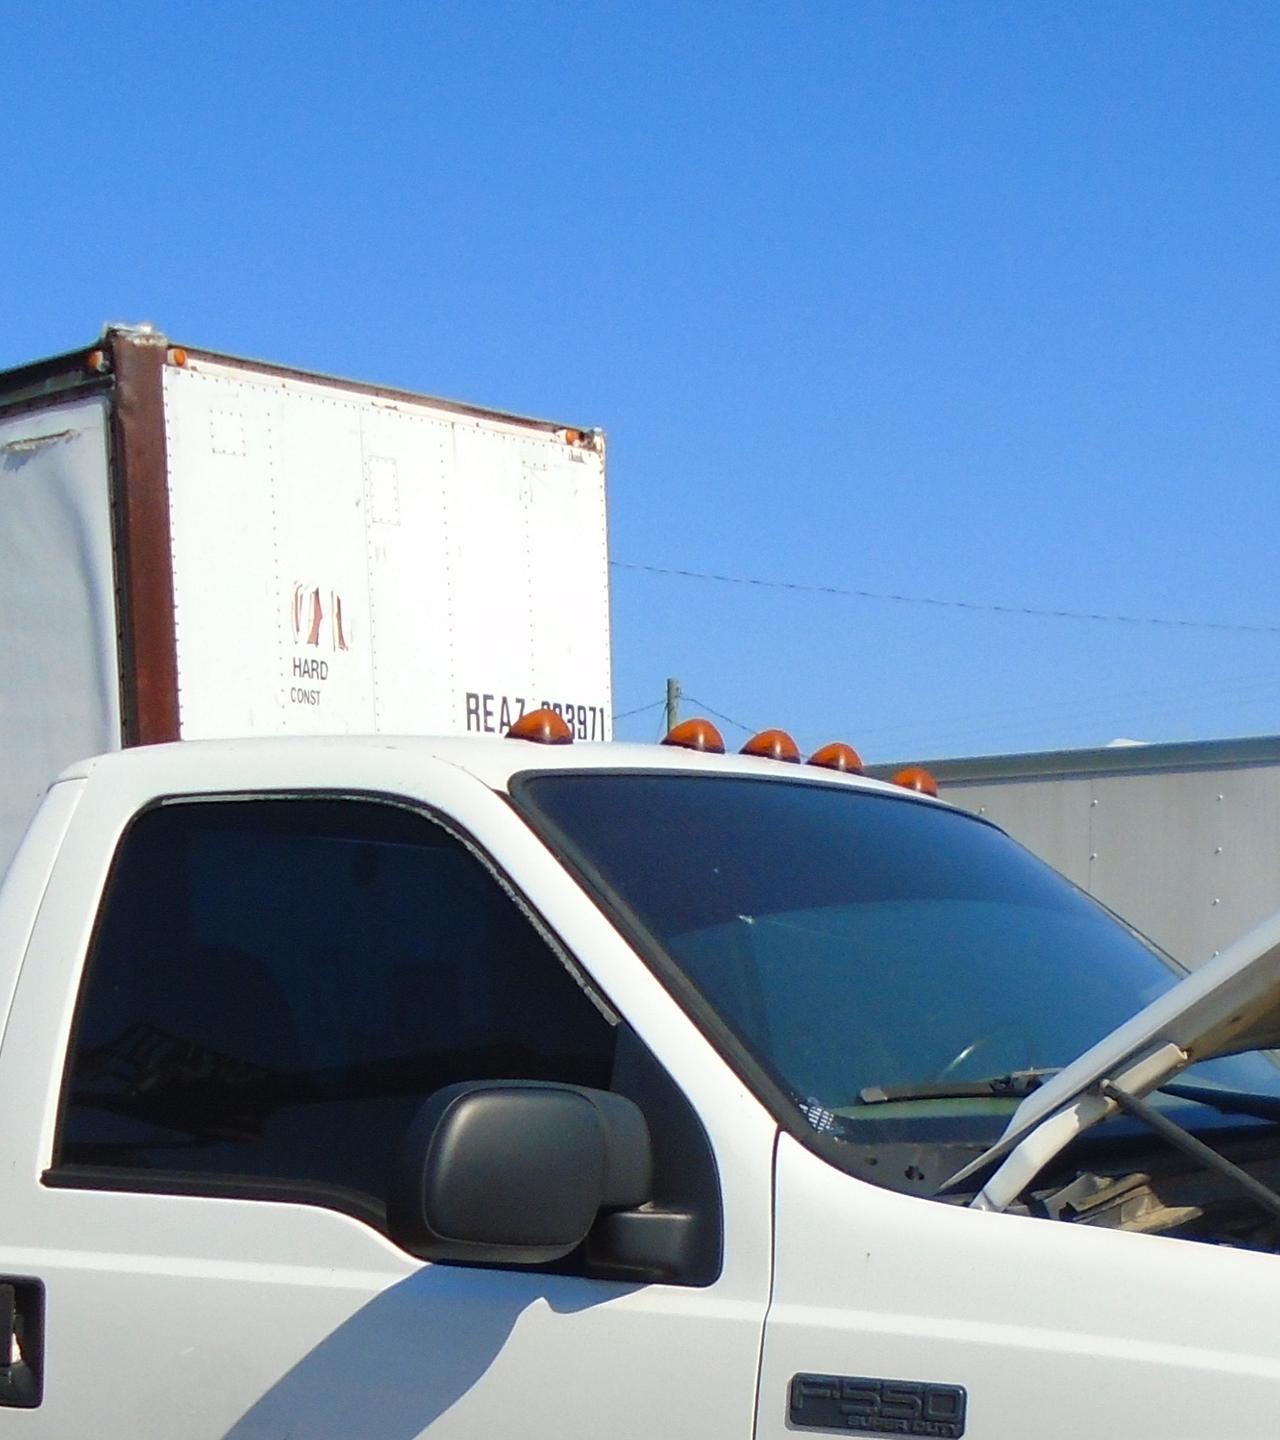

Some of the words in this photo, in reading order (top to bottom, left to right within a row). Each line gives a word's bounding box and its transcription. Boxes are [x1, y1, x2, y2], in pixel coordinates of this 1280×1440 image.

[293, 657, 328, 680] HARD
[290, 686, 321, 705] CONST
[541, 701, 605, 741] 3971
